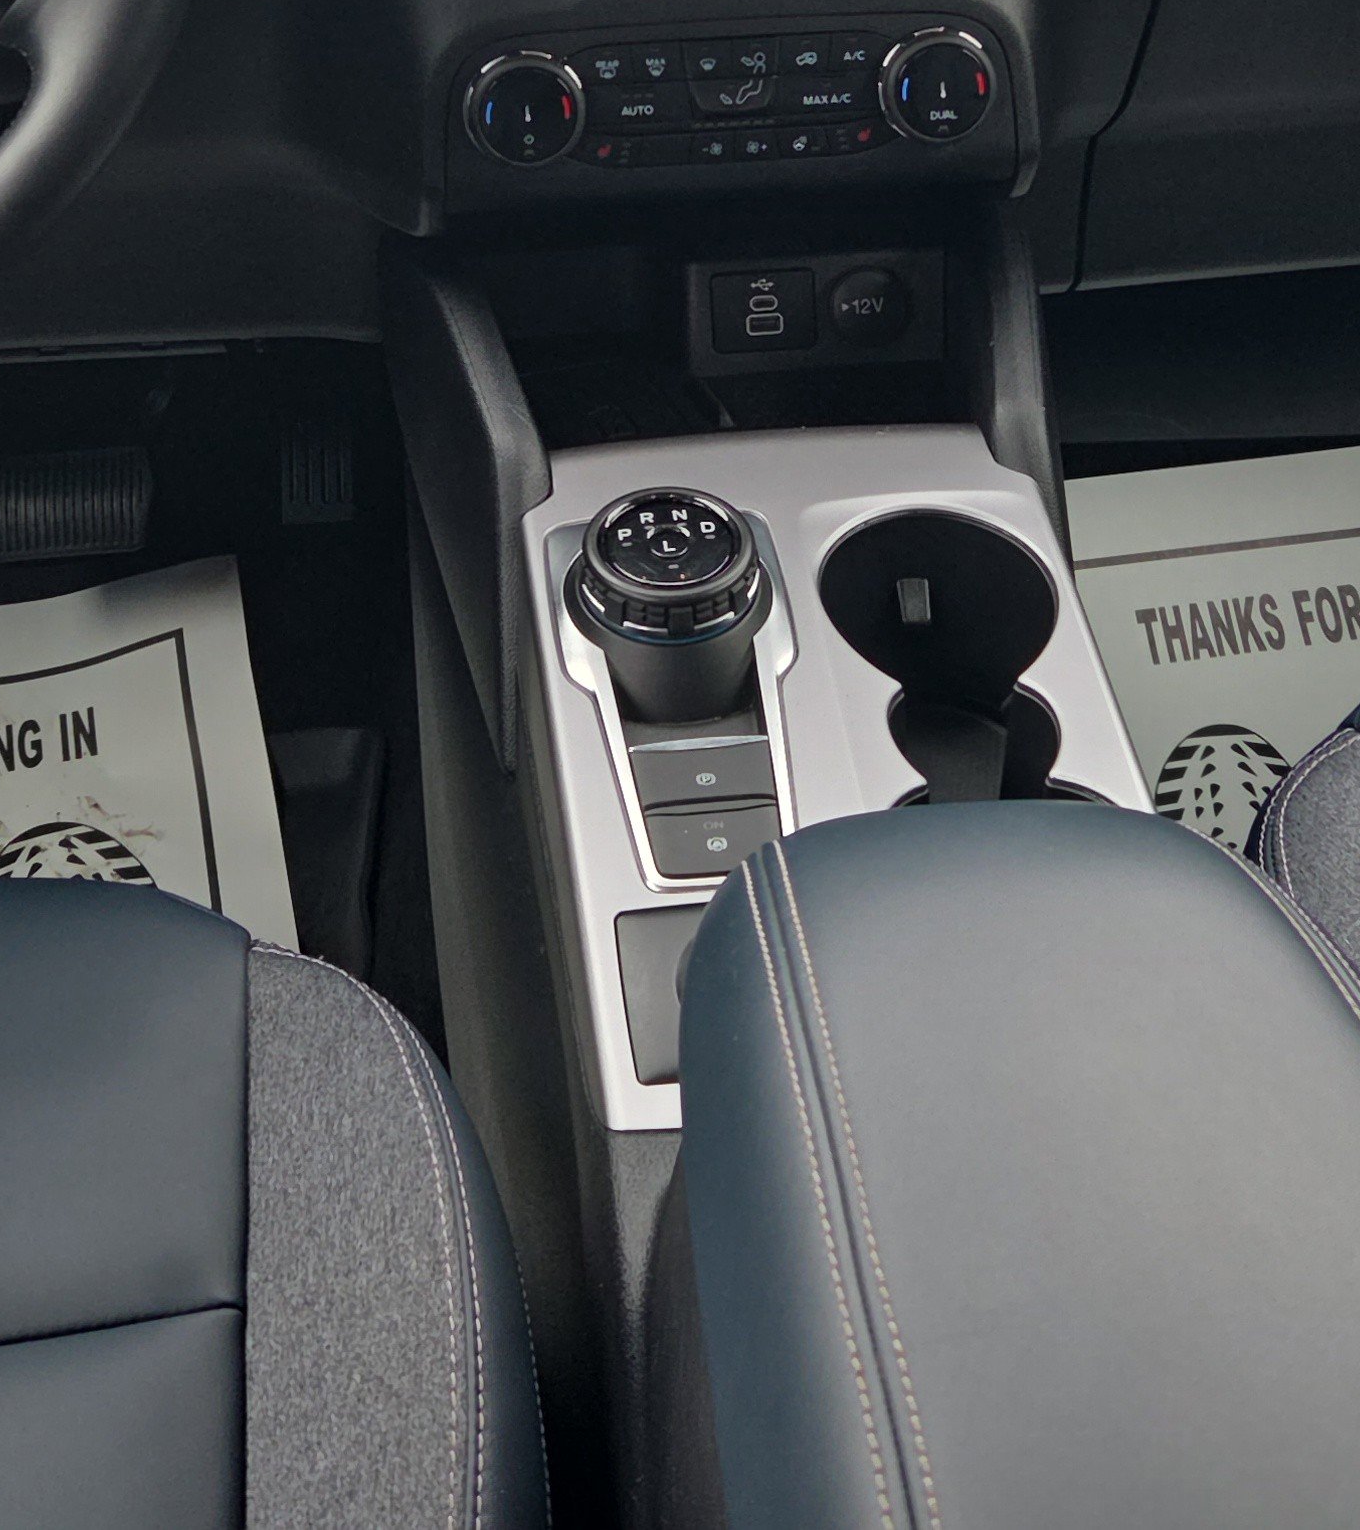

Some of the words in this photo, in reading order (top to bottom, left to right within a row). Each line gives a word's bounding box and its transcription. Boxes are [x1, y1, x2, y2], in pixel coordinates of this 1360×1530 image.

[843, 50, 866, 61] A/C
[803, 94, 828, 105] MAX
[830, 93, 851, 104] A/C
[621, 105, 654, 116] AUTO
[930, 110, 958, 121] DUAL
[852, 297, 884, 315] 12V
[639, 512, 654, 524] R
[671, 509, 688, 521] N
[700, 521, 716, 533] D
[617, 528, 632, 541] P
[662, 540, 676, 552] L
[1135, 590, 1286, 665] THANKS
[58, 706, 99, 761] IN
